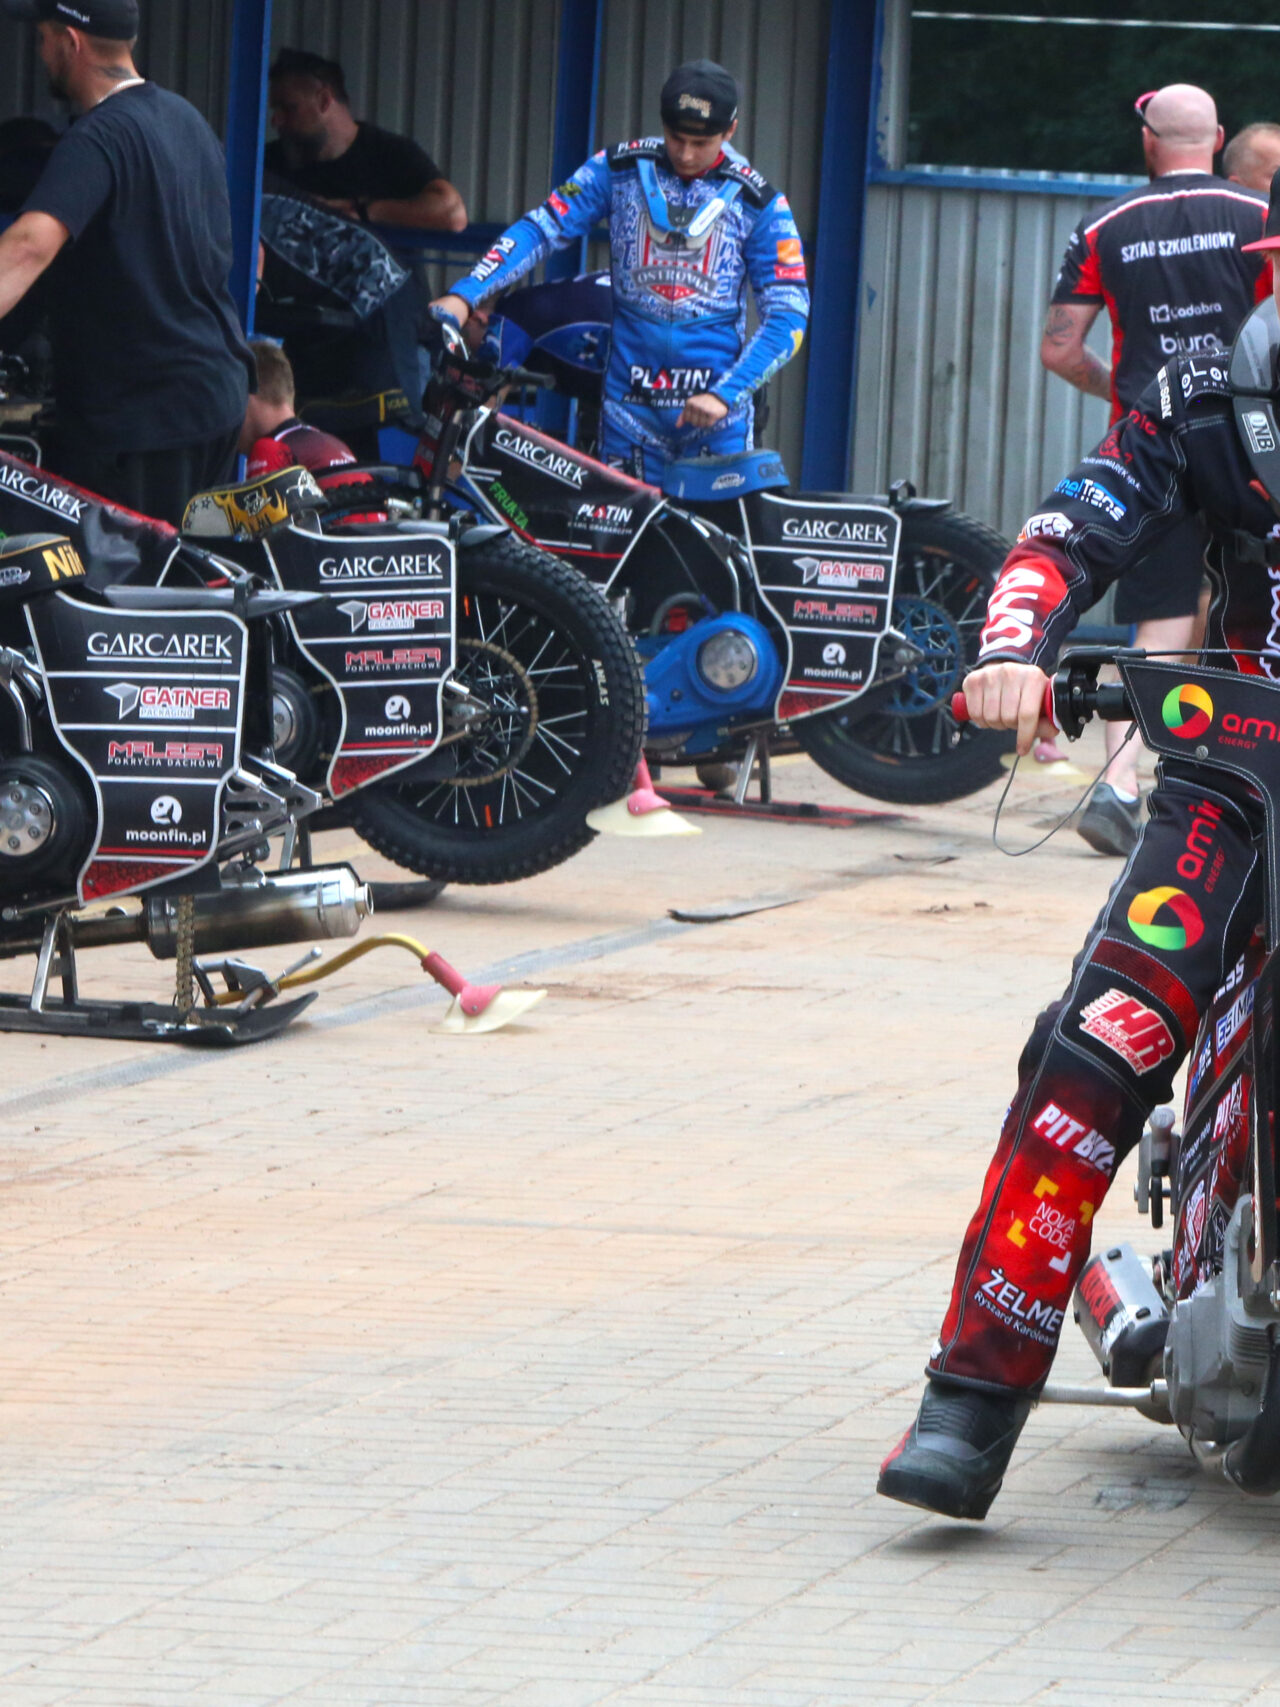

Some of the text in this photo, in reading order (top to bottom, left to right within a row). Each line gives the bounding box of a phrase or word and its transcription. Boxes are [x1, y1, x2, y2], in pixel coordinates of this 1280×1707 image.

[1121, 231, 1236, 263] SZTAB SZKOLENIOWY
[630, 365, 711, 390] PLATIN
[495, 430, 589, 485] GARCAREK
[577, 503, 633, 523] PLATIN
[782, 518, 888, 544] GARCAREK
[319, 553, 443, 580] GARCAREK
[819, 560, 884, 582] GATNER
[368, 601, 444, 620] GATNER
[87, 632, 232, 658] GARCAREK
[804, 667, 862, 681] moonfin.pl
[141, 686, 230, 709] GATNER
[365, 722, 432, 738] moonfin.pl
[1218, 736, 1259, 750] ENERGY
[108, 757, 222, 768] POKRYCIA DACHOWE
[126, 830, 206, 845] moonfin.pl
[1036, 1201, 1076, 1234] NOVA
[1029, 1217, 1072, 1250] CODE
[974, 1290, 1014, 1326] Ryszard
